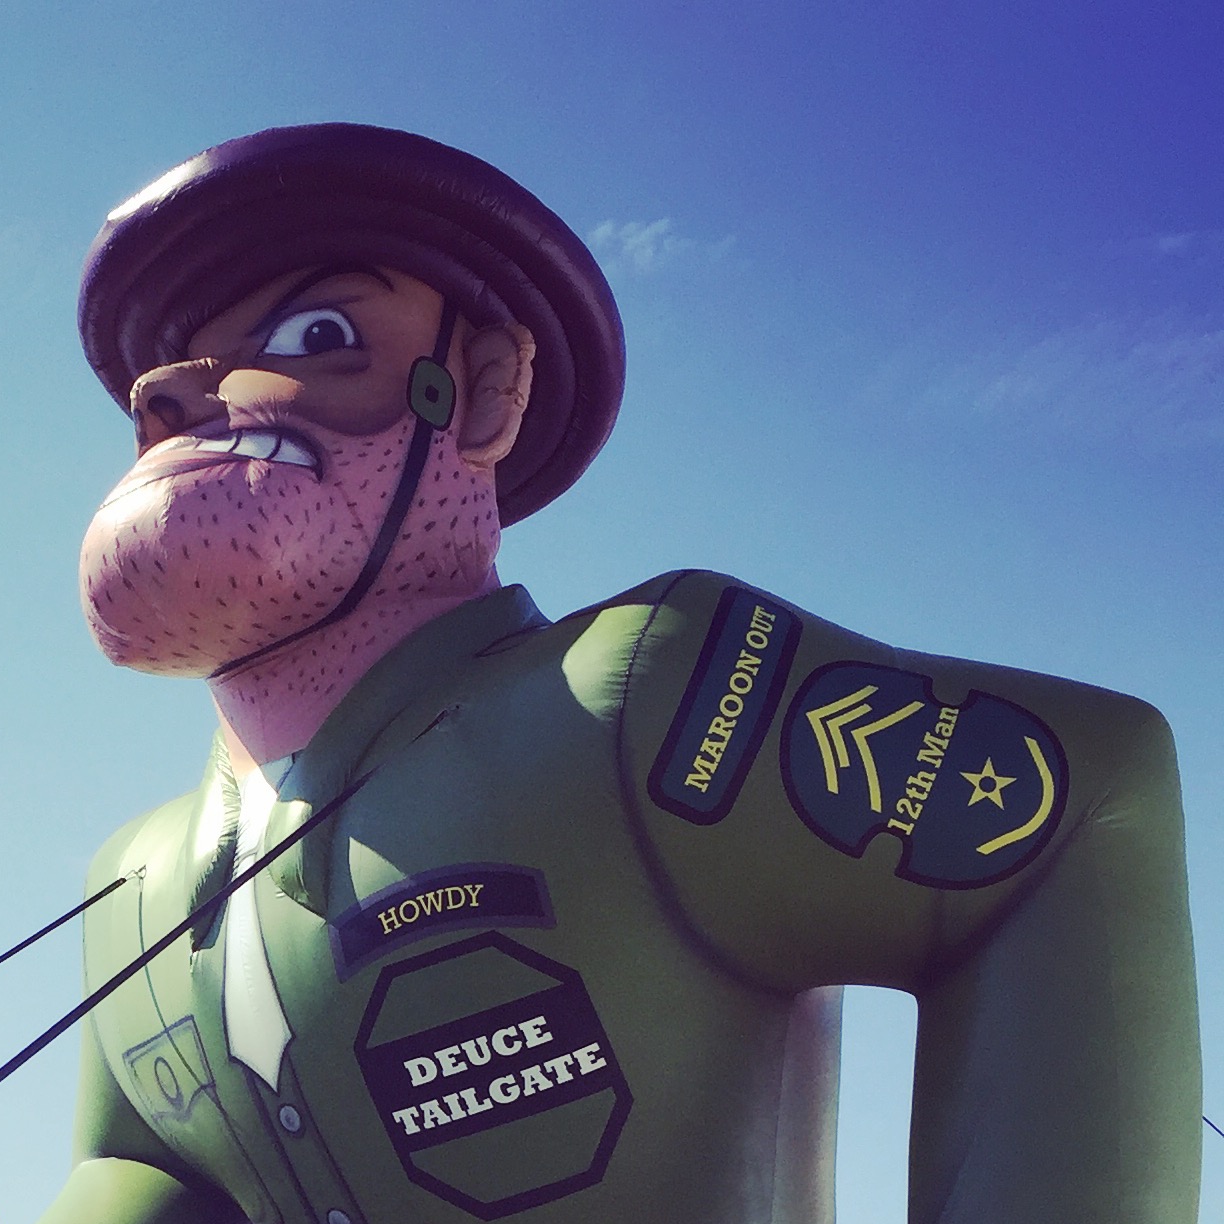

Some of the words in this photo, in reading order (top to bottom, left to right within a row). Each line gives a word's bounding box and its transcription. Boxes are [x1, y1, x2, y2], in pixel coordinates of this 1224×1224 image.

[684, 650, 763, 794] MAROON
[745, 605, 777, 653] OUT
[886, 770, 937, 837] 12th
[917, 706, 960, 770] Man
[377, 883, 484, 935] HOWDY
[392, 1042, 608, 1136] TAILGATE
[403, 1015, 554, 1087] DEUCE
